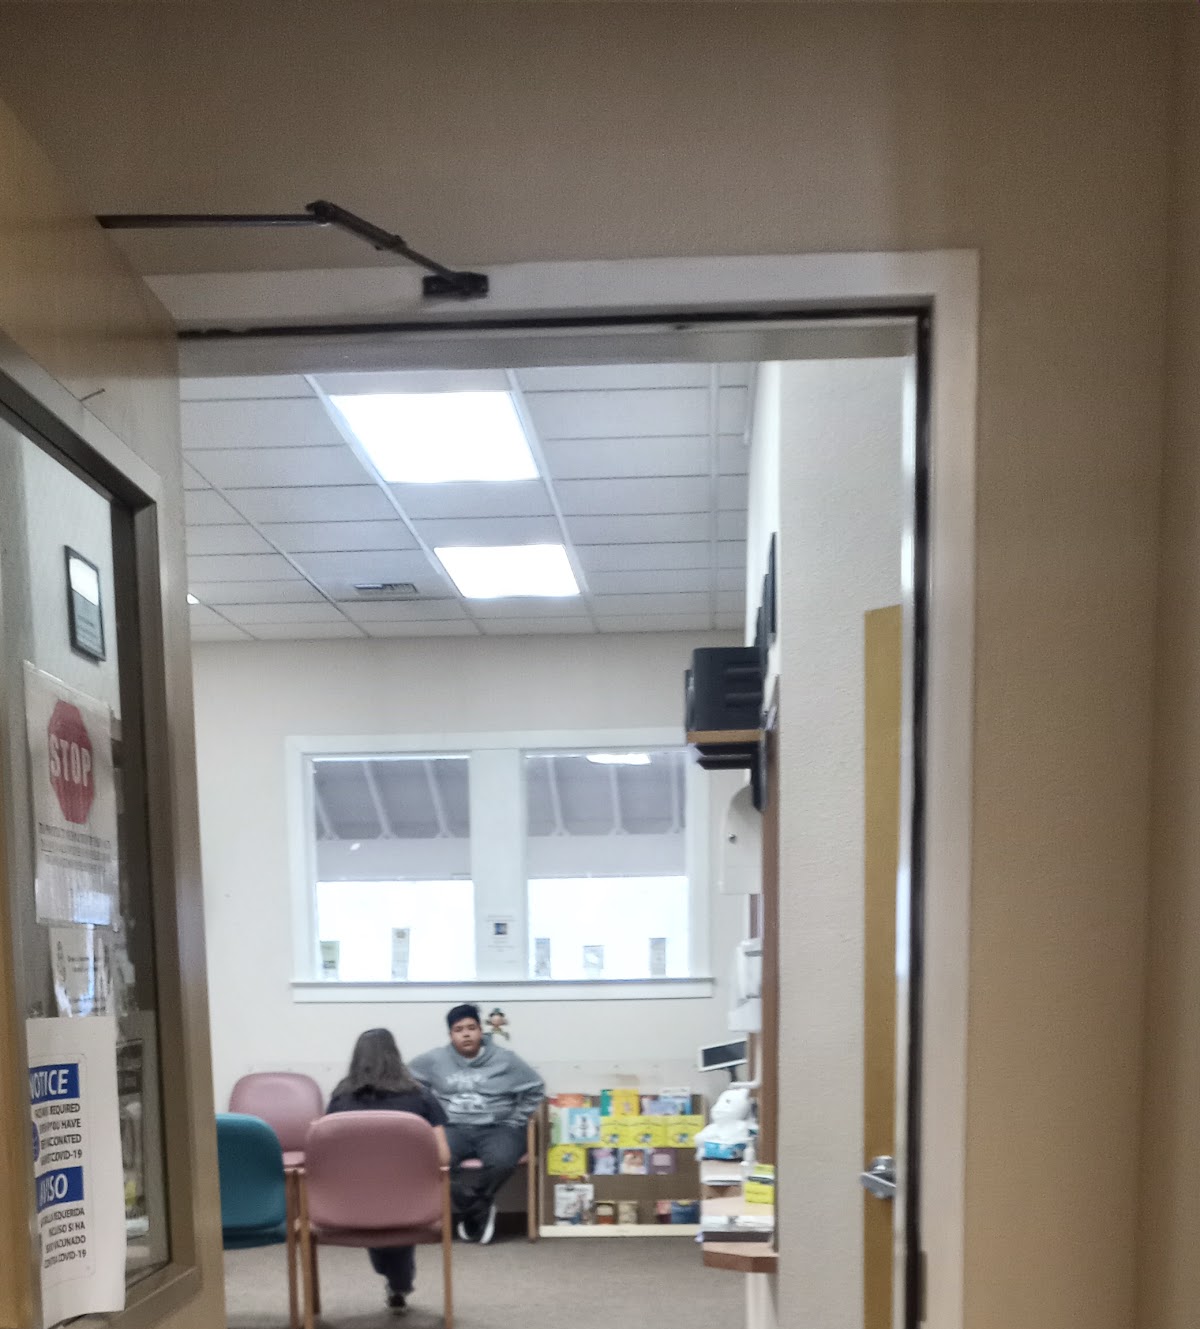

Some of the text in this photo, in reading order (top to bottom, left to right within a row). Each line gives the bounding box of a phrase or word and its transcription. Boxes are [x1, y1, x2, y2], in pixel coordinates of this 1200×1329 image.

[50, 733, 91, 787] STOP
[61, 1118, 82, 1129] HAVE
[51, 1149, 83, 1162] COVID-19
[58, 1249, 87, 1263] COVID-19
